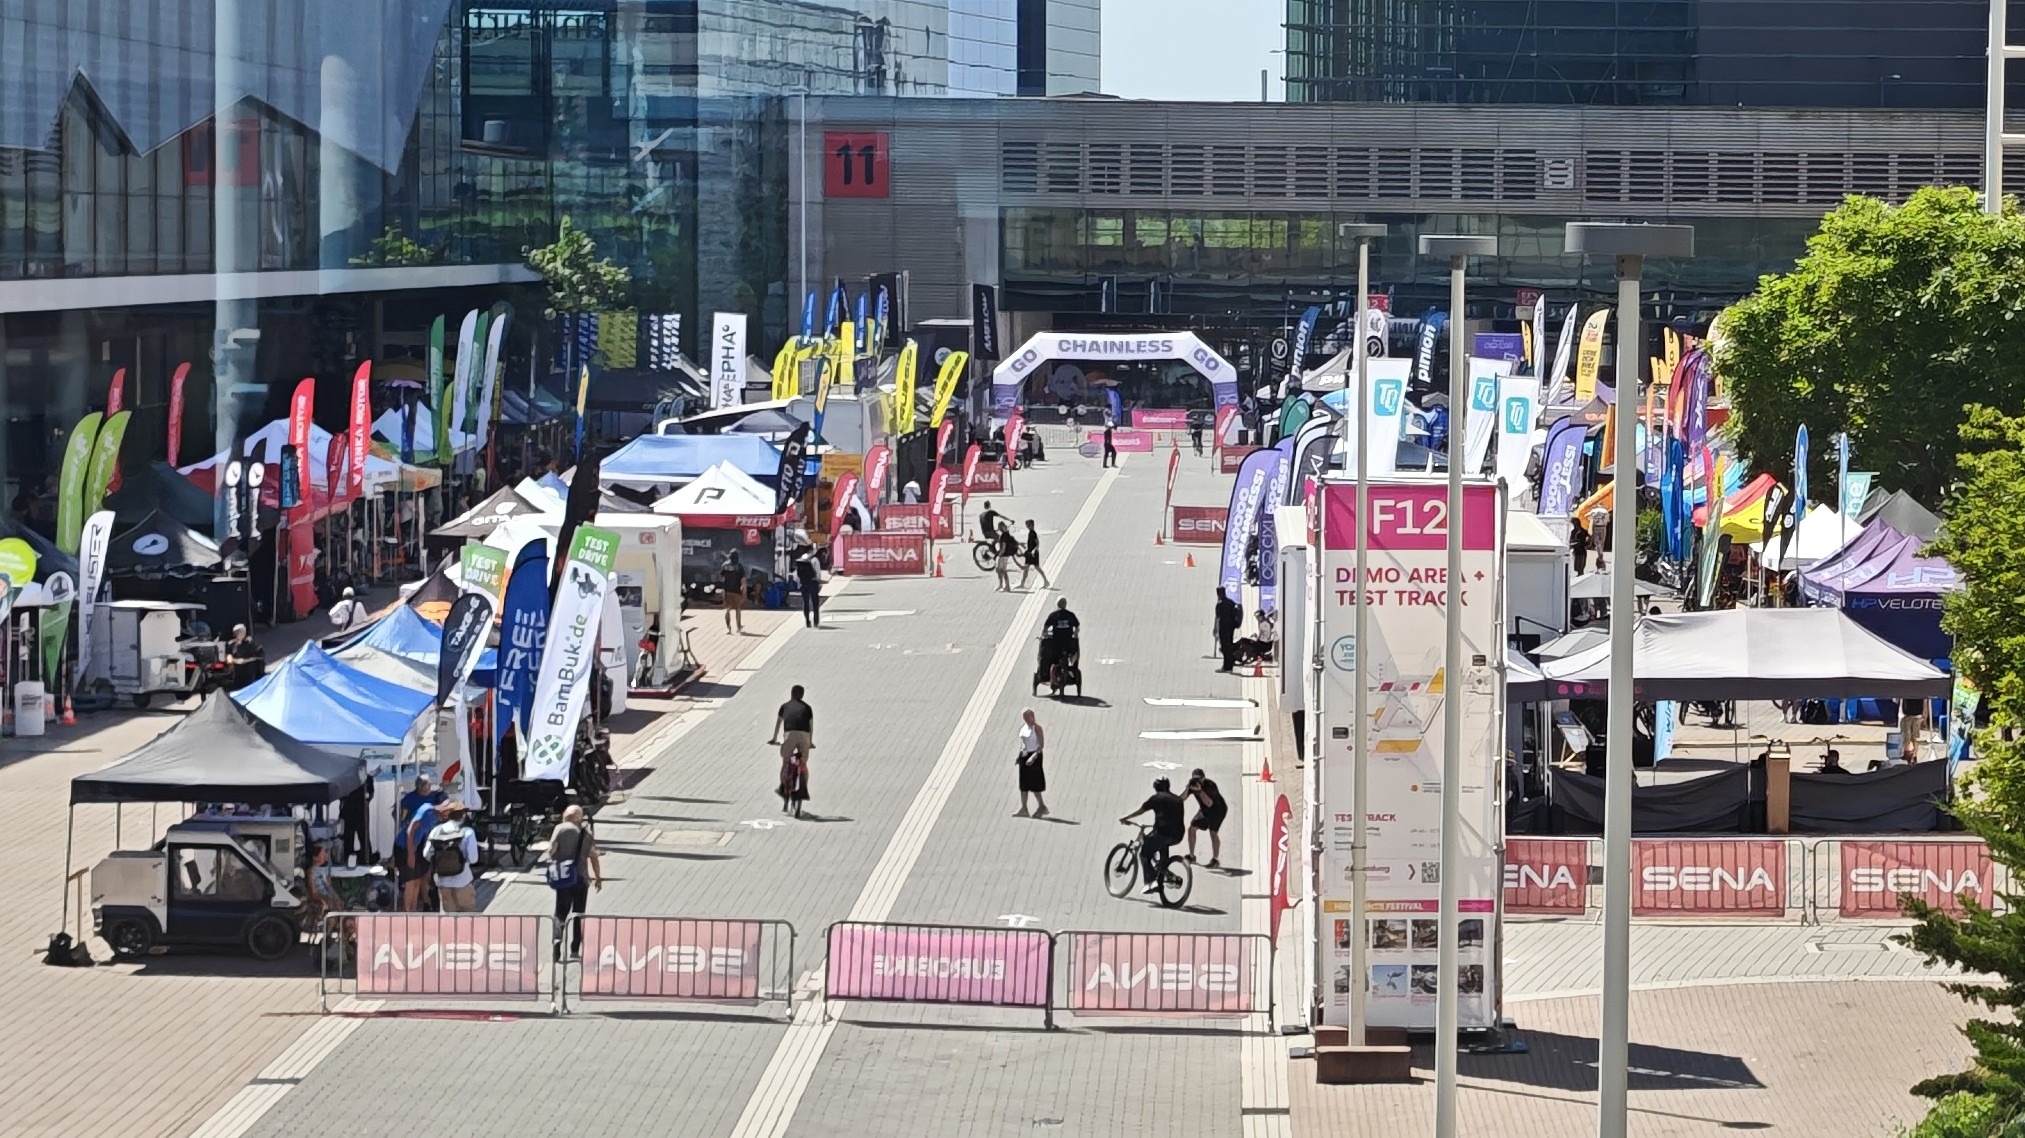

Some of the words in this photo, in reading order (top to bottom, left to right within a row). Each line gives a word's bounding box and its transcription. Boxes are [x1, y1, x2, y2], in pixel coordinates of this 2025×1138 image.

[836, 142, 874, 185] 11
[1058, 338, 1174, 355] CHAINLESS
[1193, 347, 1220, 372] GO
[1418, 323, 1437, 383] pinion
[1011, 348, 1039, 374] GO
[1379, 382, 1399, 414] TQ
[1510, 402, 1528, 429] TQ
[948, 472, 1000, 485] SNA
[1179, 519, 1226, 532] SEN
[1373, 499, 1449, 535] F12
[585, 536, 609, 552] TEST
[847, 548, 918, 562] SENA
[470, 553, 498, 571] TEST
[577, 548, 609, 567] DRIVE
[464, 567, 499, 586] DRIVE
[547, 612, 589, 727] BamBuk.de
[1503, 863, 1576, 890] ENA
[1643, 866, 1775, 892] SENA
[1850, 867, 1983, 895] SENA
